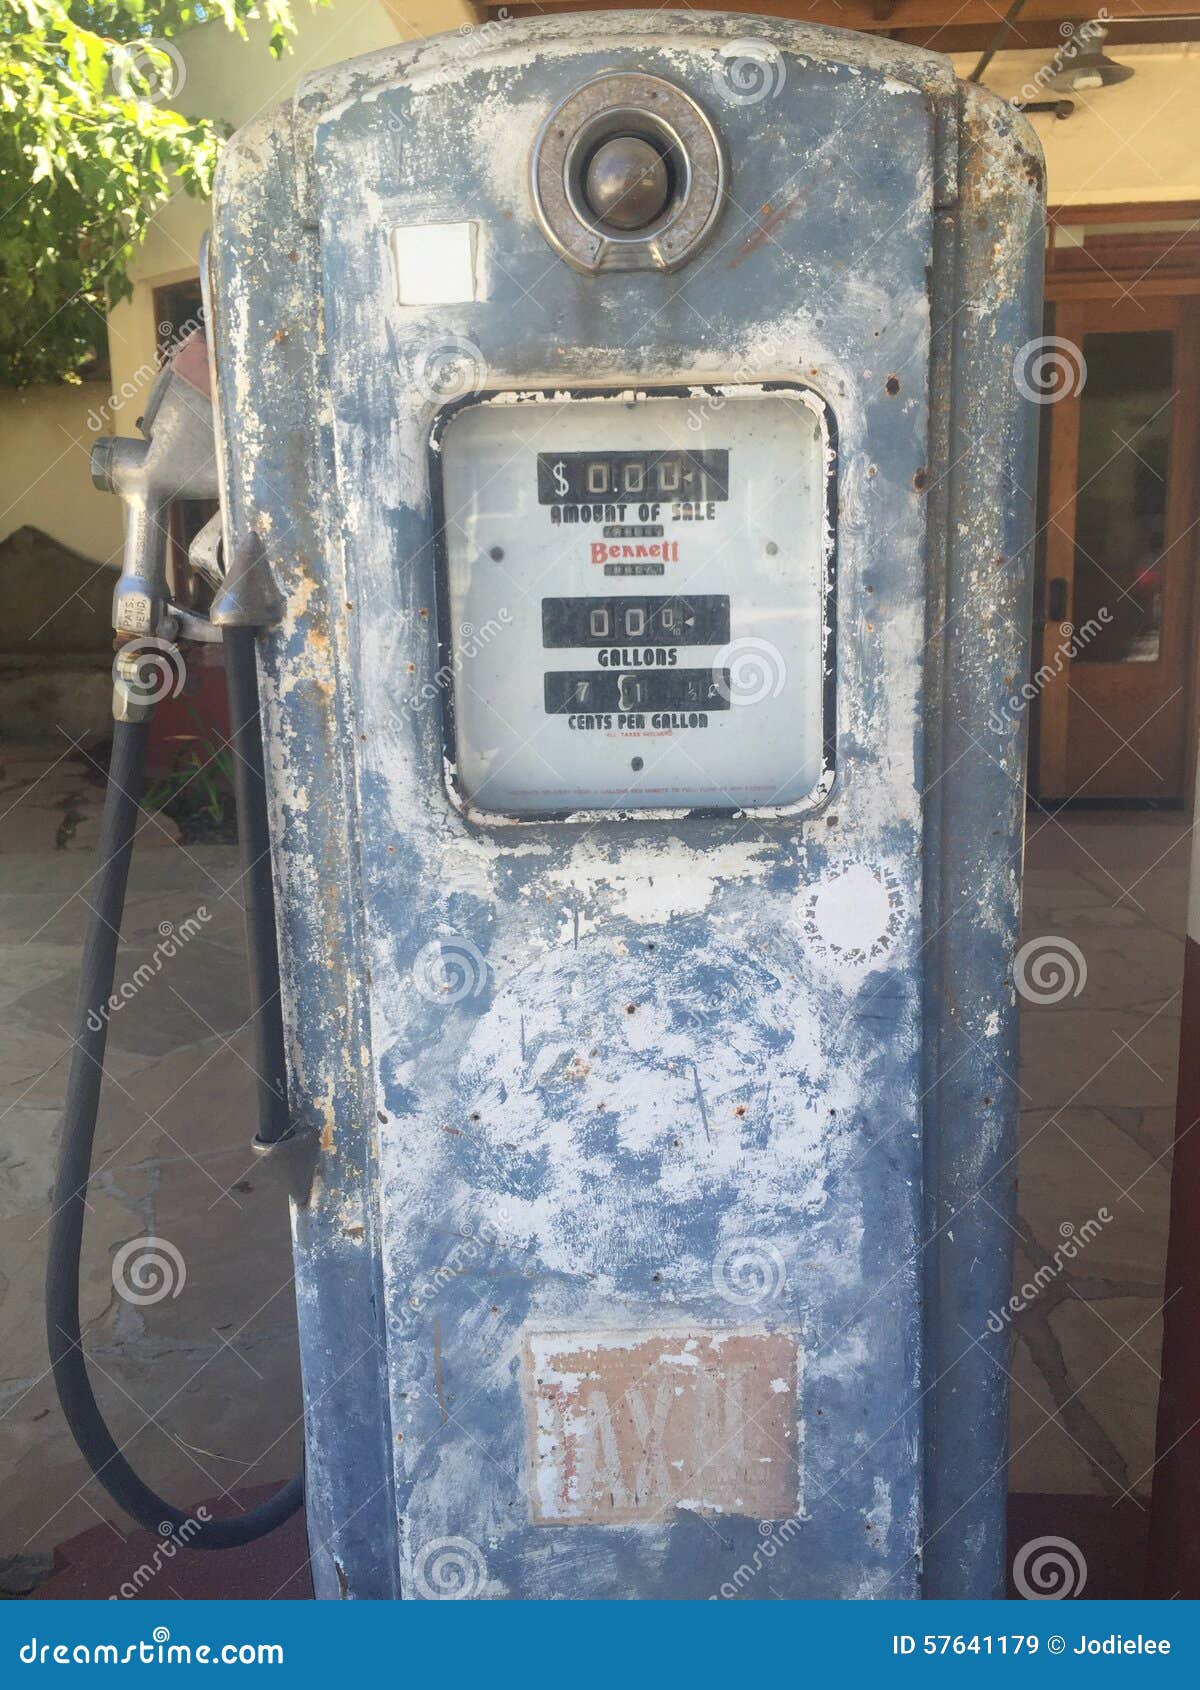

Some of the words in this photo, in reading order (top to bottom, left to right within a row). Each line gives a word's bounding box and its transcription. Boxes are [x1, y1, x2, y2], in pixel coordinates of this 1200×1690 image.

[551, 503, 628, 524] AMOUNT
[638, 503, 660, 522] OF
[671, 502, 716, 521] SALE
[590, 540, 679, 564] Bennett
[597, 648, 677, 667] GALLONS
[568, 714, 612, 730] CENTS
[618, 714, 645, 729] PER
[652, 713, 708, 729] GALLON
